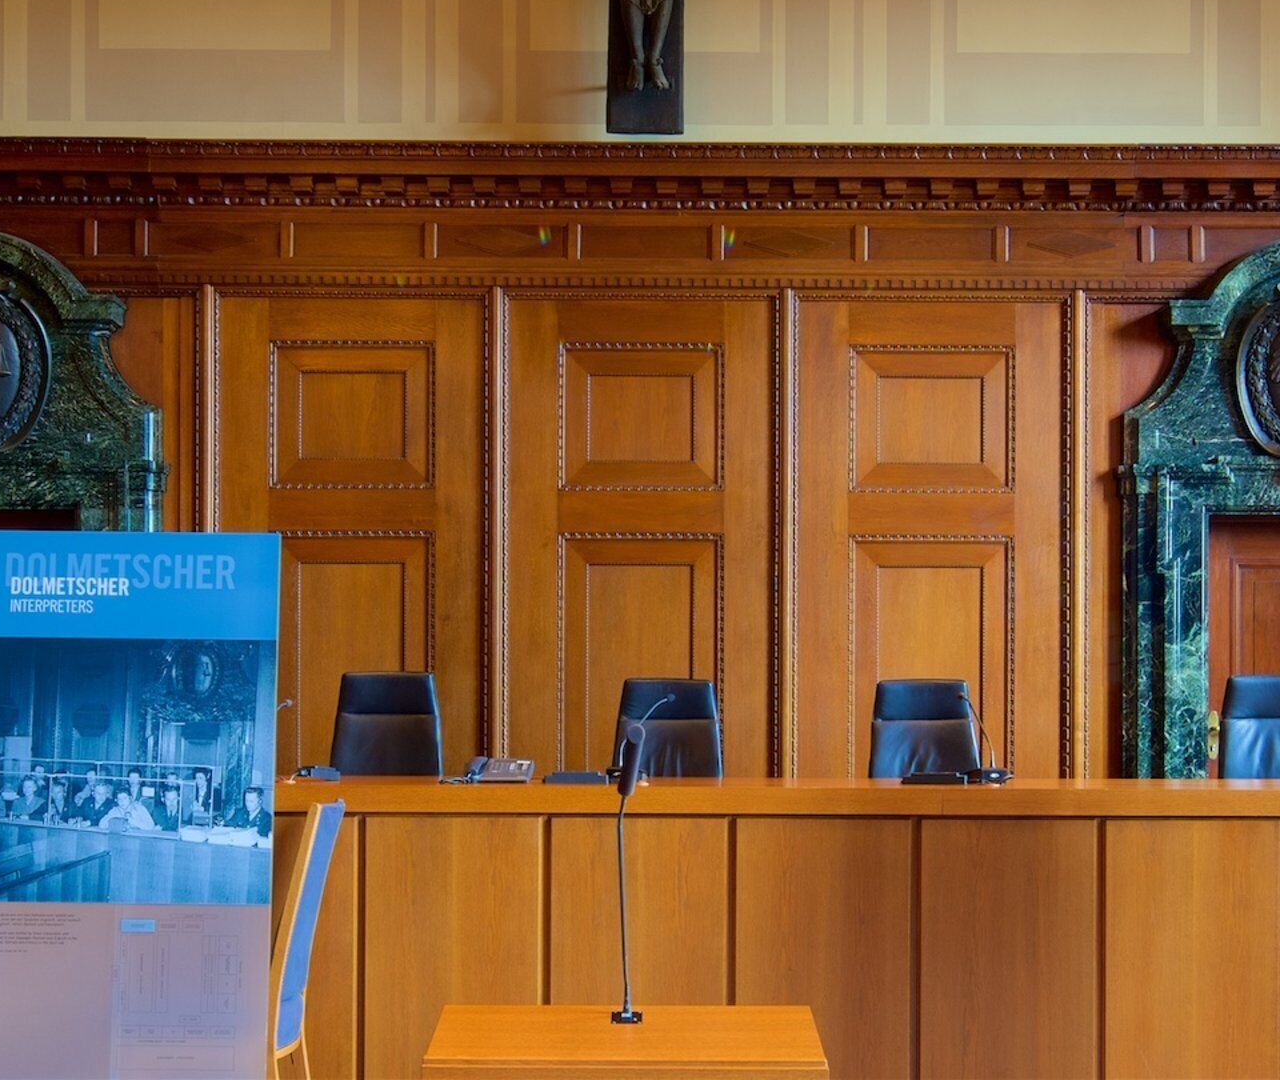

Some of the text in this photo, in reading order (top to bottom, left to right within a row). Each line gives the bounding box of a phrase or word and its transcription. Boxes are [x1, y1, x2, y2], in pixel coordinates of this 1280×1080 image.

[5, 552, 236, 590] DOLMETSCHER
[10, 576, 130, 596] DOLMETSCHER
[10, 598, 94, 614] INTERPRETERS
